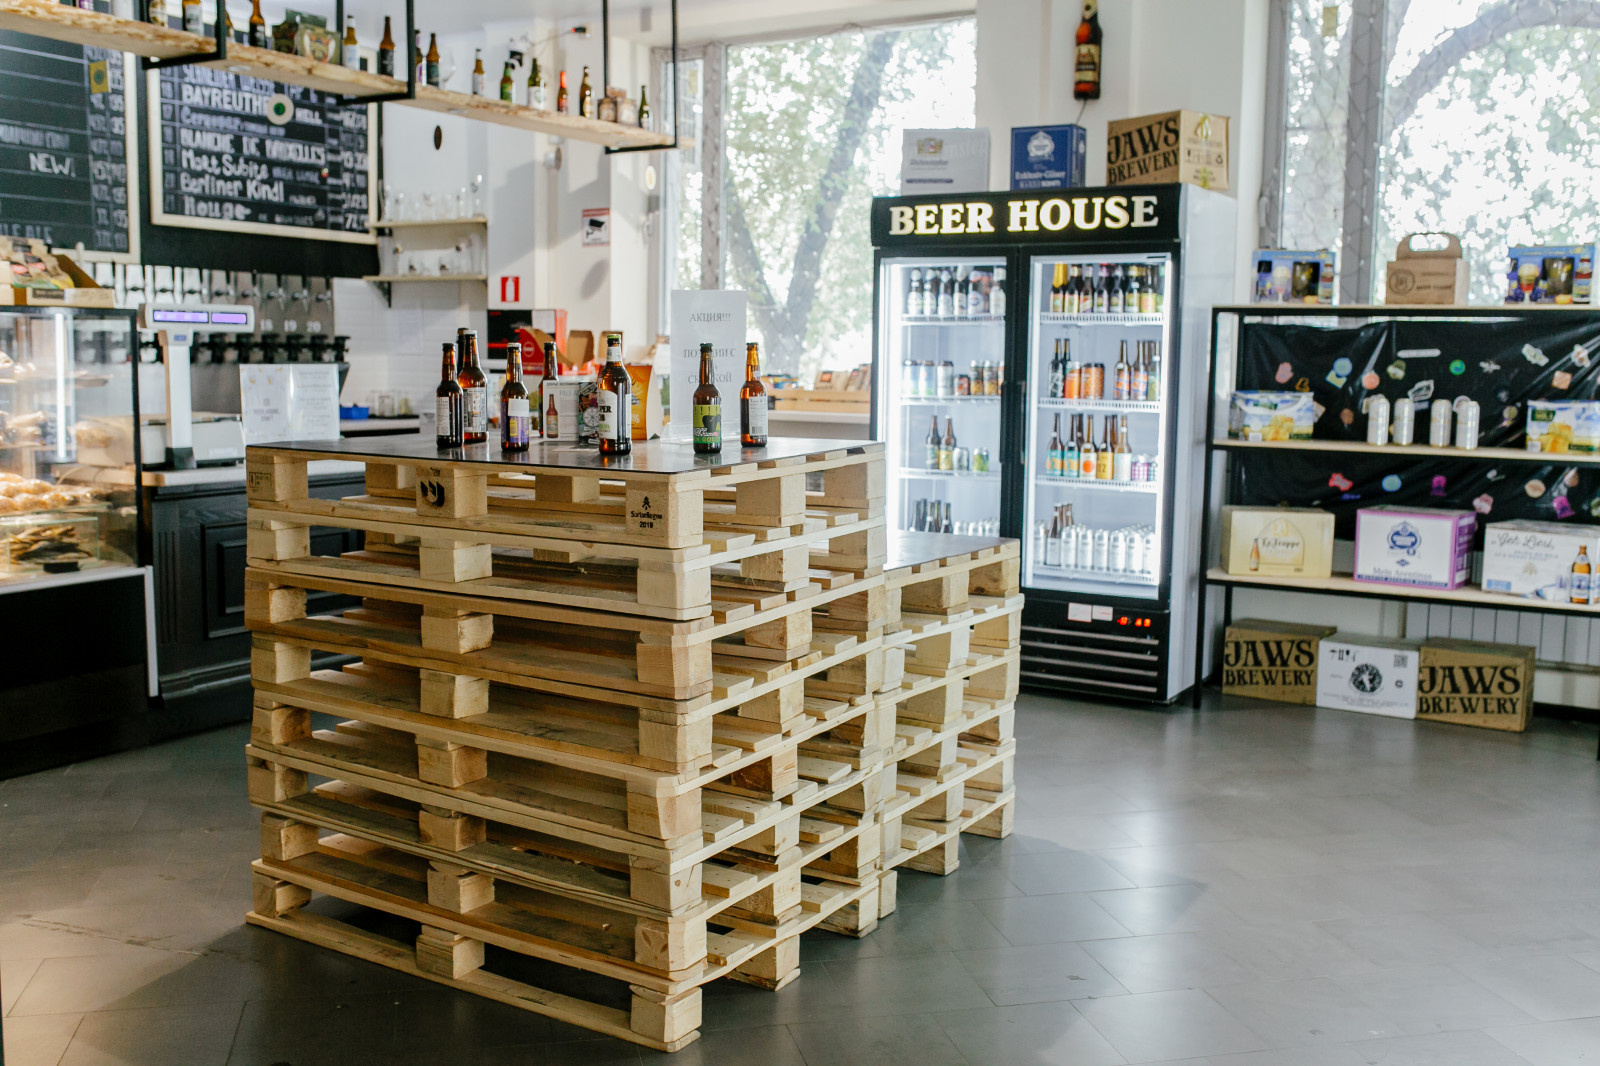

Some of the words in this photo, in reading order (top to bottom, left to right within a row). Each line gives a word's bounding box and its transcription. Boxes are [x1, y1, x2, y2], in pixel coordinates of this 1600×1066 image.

[1107, 117, 1179, 165] JAWS
[28, 152, 76, 178] NEW!
[221, 154, 270, 181] Subite
[1108, 149, 1179, 184] BREWERY
[180, 172, 243, 197] Berliner
[246, 178, 284, 203] Kindl
[184, 195, 252, 222] Rouge
[888, 202, 995, 236] BEER
[1006, 195, 1159, 232] HOUSE
[689, 312, 731, 323] АКЦИЯ!!!
[1224, 640, 1314, 668] JAWS
[1223, 669, 1314, 687] BREWERY
[1418, 665, 1521, 695] JAWS
[1417, 695, 1520, 715] BREWERY
